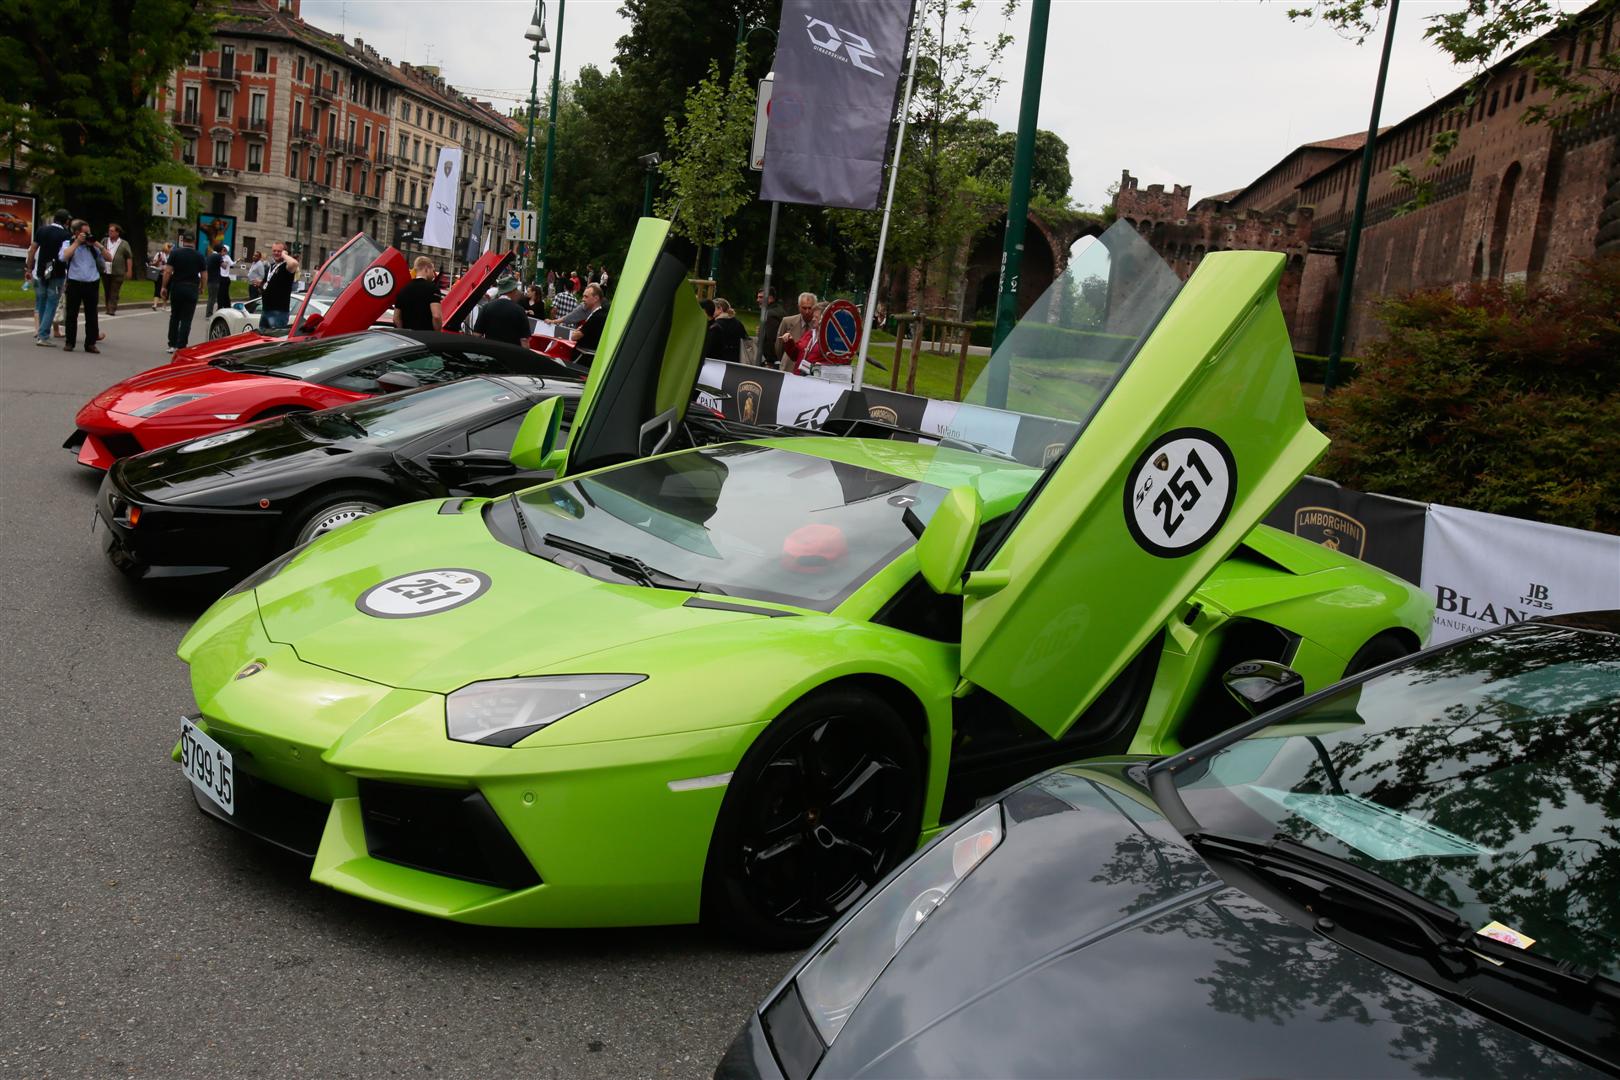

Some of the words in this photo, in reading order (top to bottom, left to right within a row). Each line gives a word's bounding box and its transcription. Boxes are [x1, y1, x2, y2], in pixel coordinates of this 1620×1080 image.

[368, 272, 389, 290] 041
[1152, 447, 1214, 539] 251
[1299, 511, 1360, 541] LAMBORGHINI
[386, 578, 464, 605] 251
[1434, 584, 1543, 626] BLAN
[1519, 596, 1554, 611] 1735
